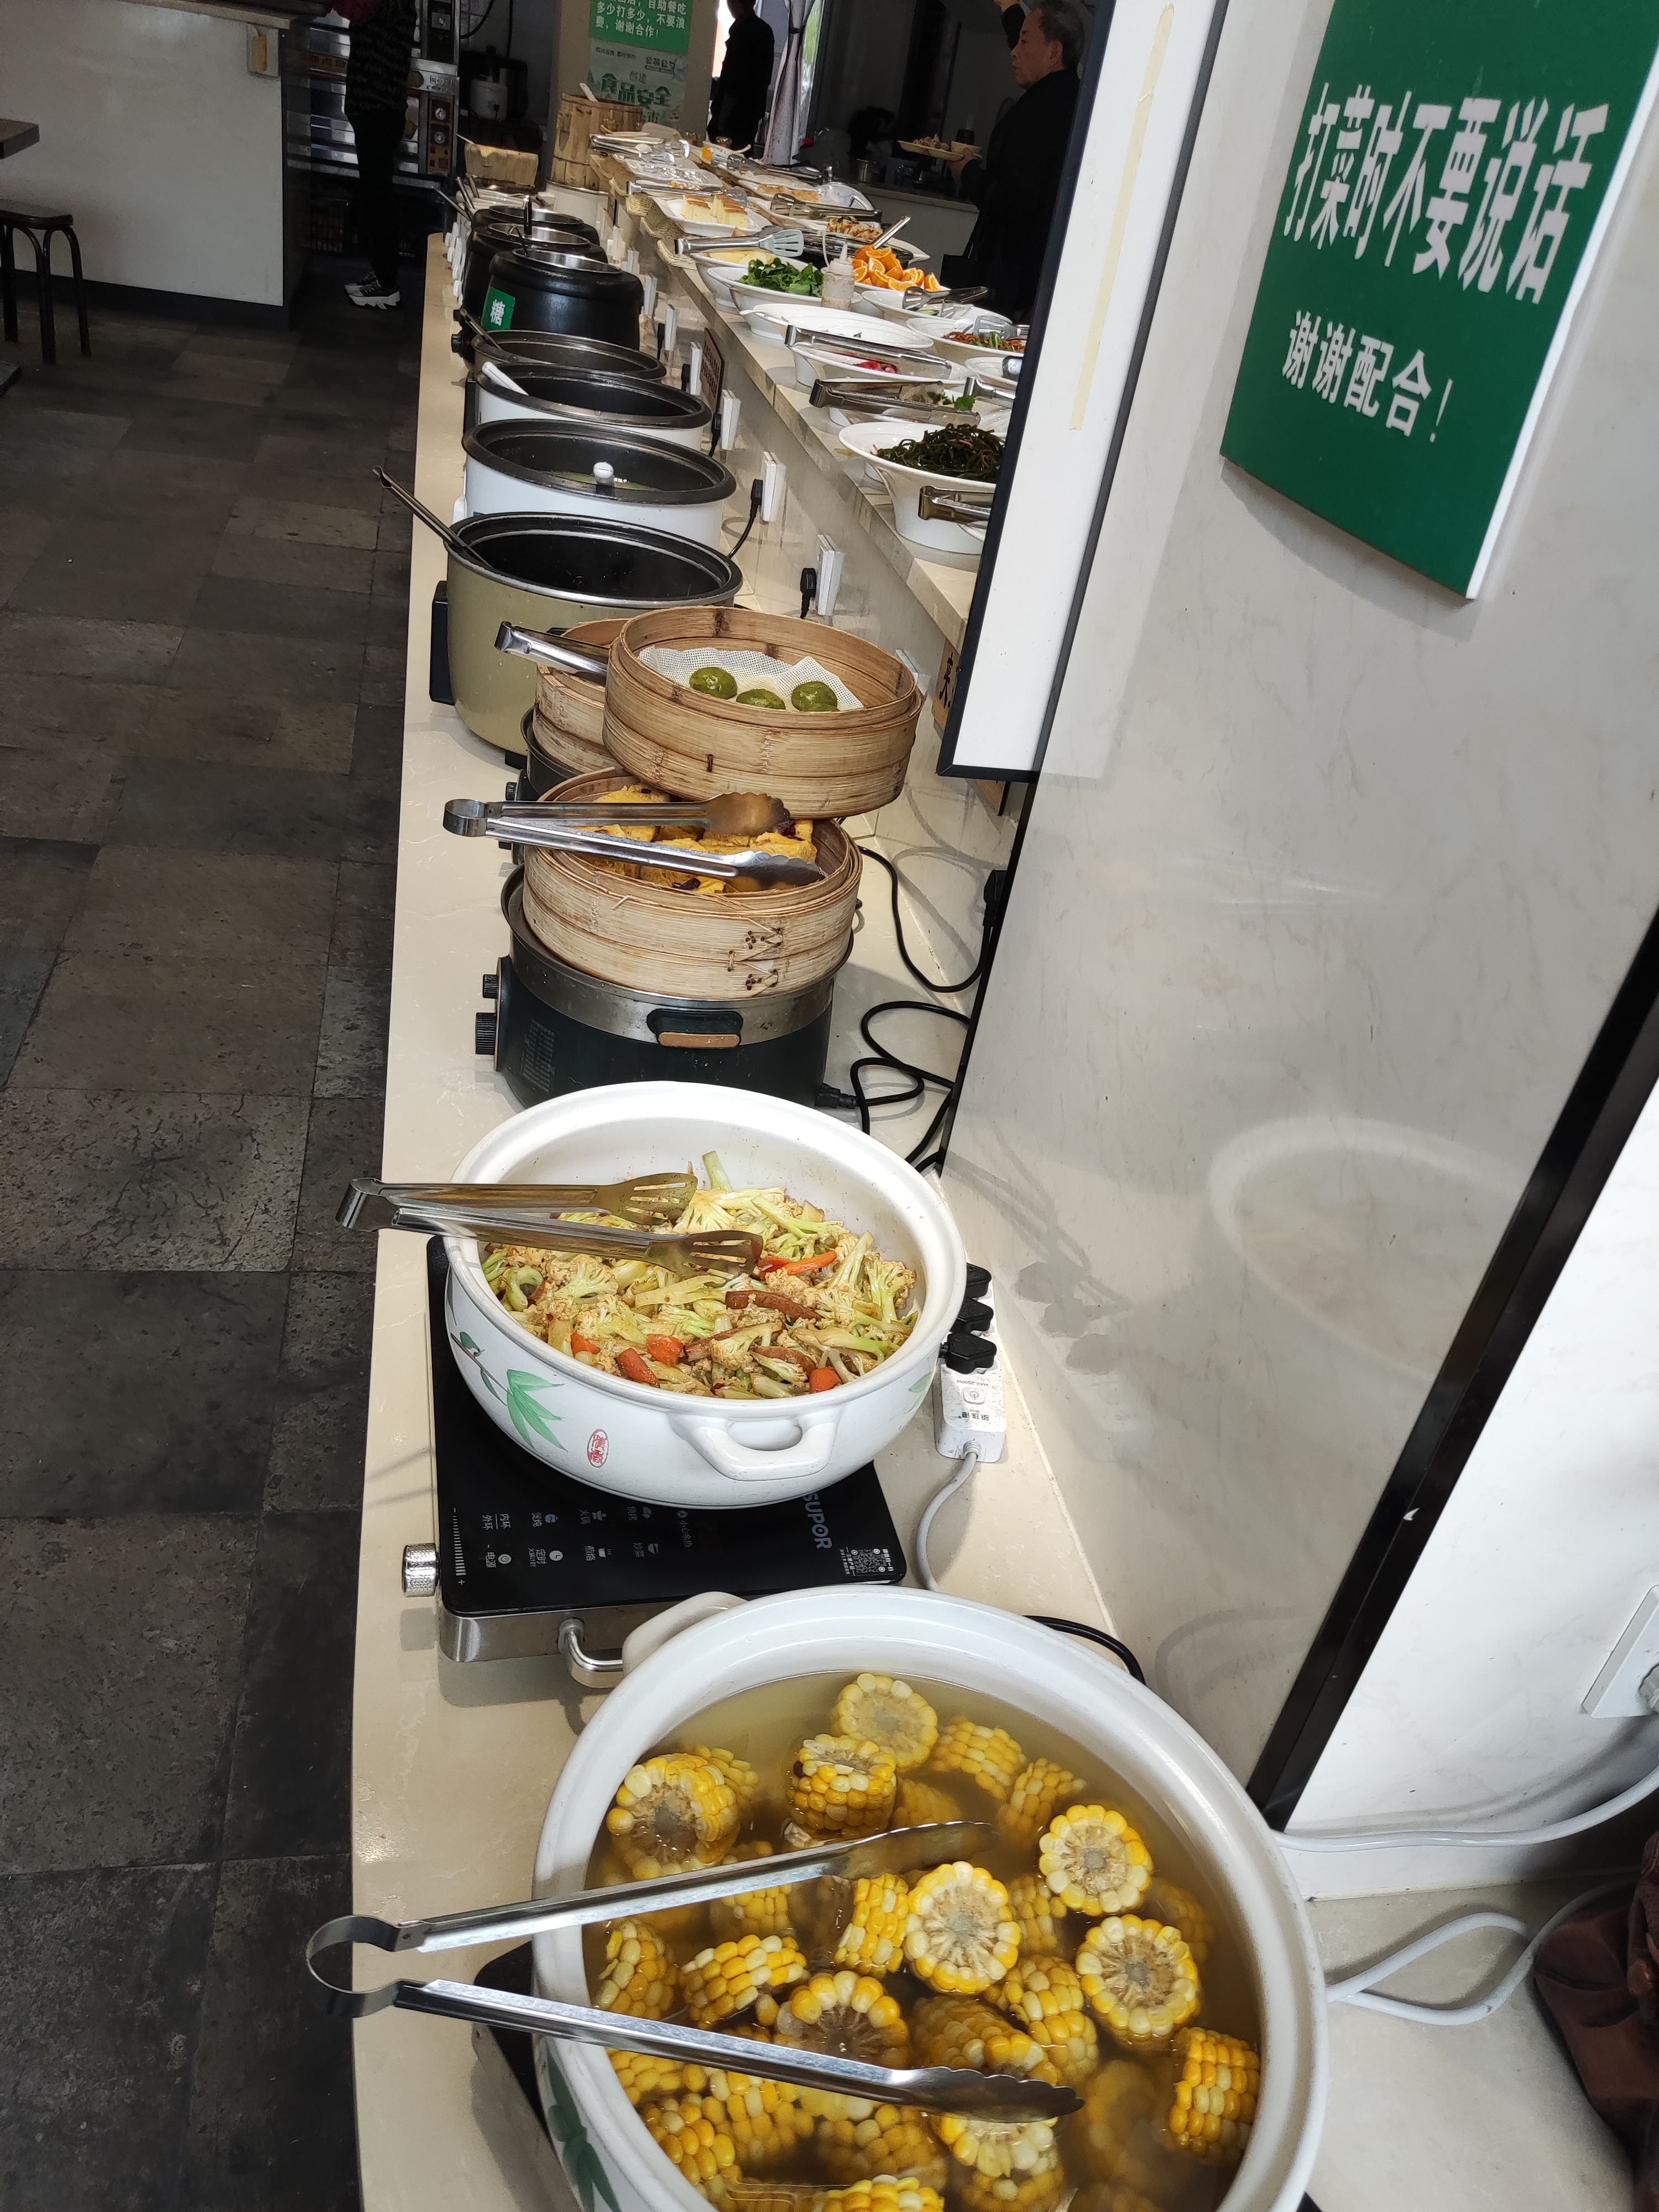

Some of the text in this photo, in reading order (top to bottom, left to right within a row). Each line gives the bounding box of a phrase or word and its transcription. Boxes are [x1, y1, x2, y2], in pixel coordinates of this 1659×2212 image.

[601, 73, 672, 109] 食品安全
[1283, 82, 1610, 305] 打菜时不要说话
[490, 299, 506, 326] 糖
[1282, 309, 1453, 442] 谢谢配合！
[482, 1515, 493, 1530] 外环
[499, 1514, 511, 1529] 内环
[579, 1509, 591, 1525] 火锅
[802, 1493, 833, 1549] SUPOR
[485, 1552, 497, 1568] 电源
[535, 1549, 547, 1564] 定时
